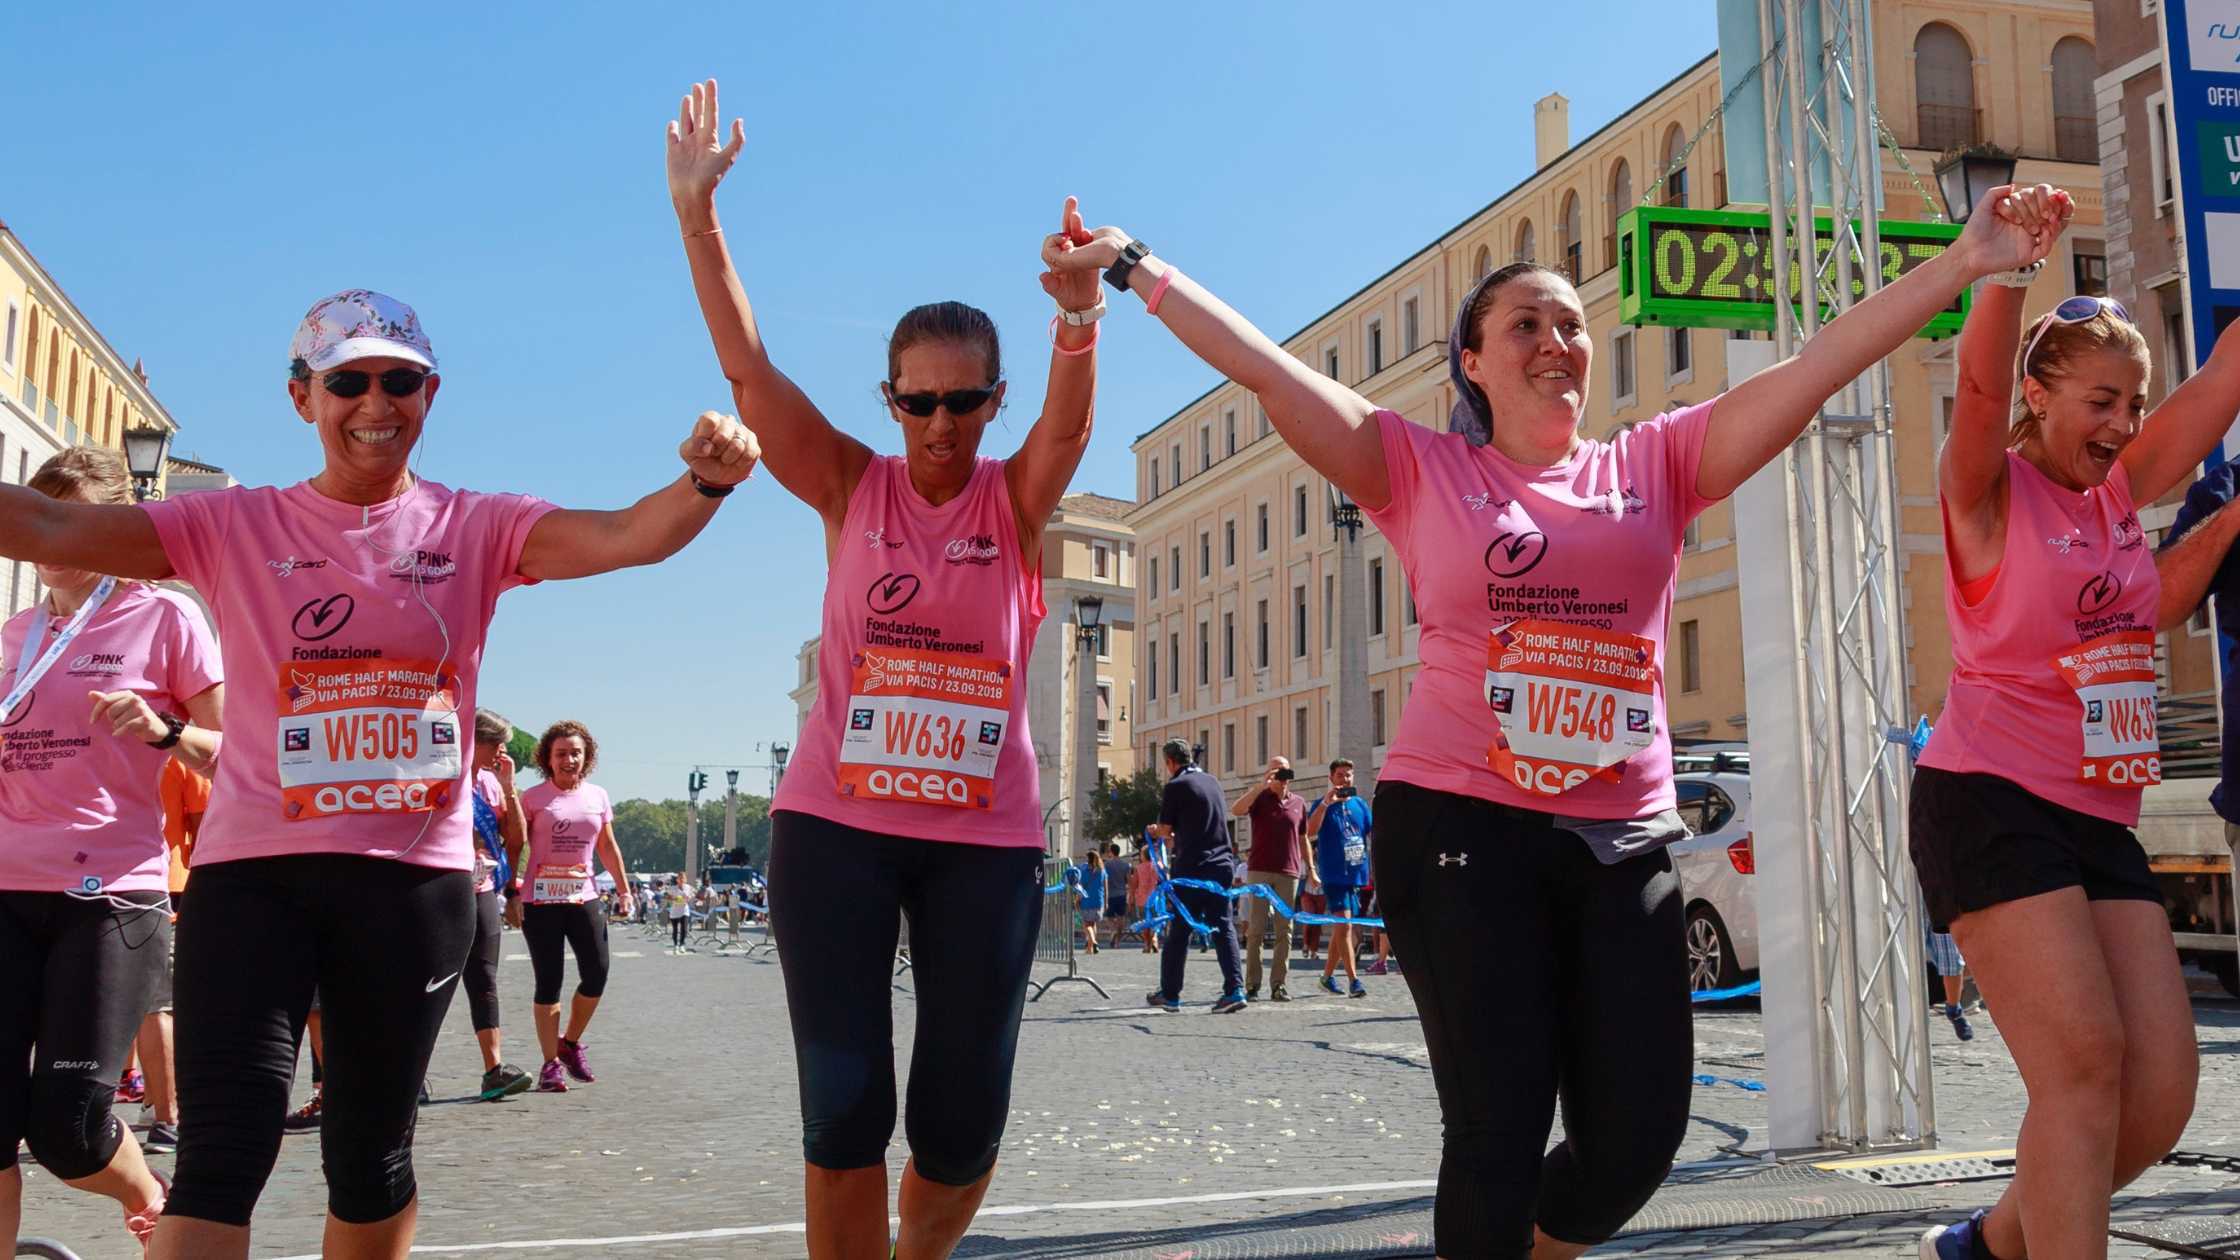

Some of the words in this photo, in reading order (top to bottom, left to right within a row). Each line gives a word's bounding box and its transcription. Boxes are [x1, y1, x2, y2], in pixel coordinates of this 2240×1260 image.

[2207, 23, 2240, 39] ru
[2207, 86, 2240, 107] OFFI
[417, 550, 453, 567] PINK
[1487, 583, 1580, 600] Fondazione
[1488, 598, 1558, 615] Umberto
[1563, 598, 1628, 615] Veronesi
[866, 617, 941, 638] Fondazione
[866, 631, 922, 650] Umberto
[924, 638, 984, 654] Veronesi
[1526, 633, 1558, 649] ROME
[1562, 637, 1591, 652] HALF
[92, 653, 125, 665] PINK
[292, 645, 382, 660] Fondazione
[2084, 646, 2111, 662] ROME
[887, 658, 917, 673] ROME
[919, 660, 944, 676] HALF
[947, 666, 1004, 685] MARATHON
[1526, 651, 1546, 664] VIA
[1550, 653, 1584, 669] PACIS
[1593, 660, 1649, 680] 23.09.2018
[317, 673, 351, 688] ROME
[354, 671, 384, 684] HALF
[886, 674, 904, 687] VIA
[906, 675, 938, 690] PACIS
[946, 681, 1003, 699] 23.09.2018
[318, 690, 339, 703] VIA
[342, 686, 378, 700] PACIS
[1528, 682, 1616, 743] W548
[41, 736, 91, 749] Veronesi
[323, 713, 418, 762] W505
[885, 710, 966, 762] W636
[23, 749, 76, 762] progresso
[867, 769, 968, 803] acea
[315, 783, 428, 813] acea
[53, 1060, 92, 1069] CRAFT
